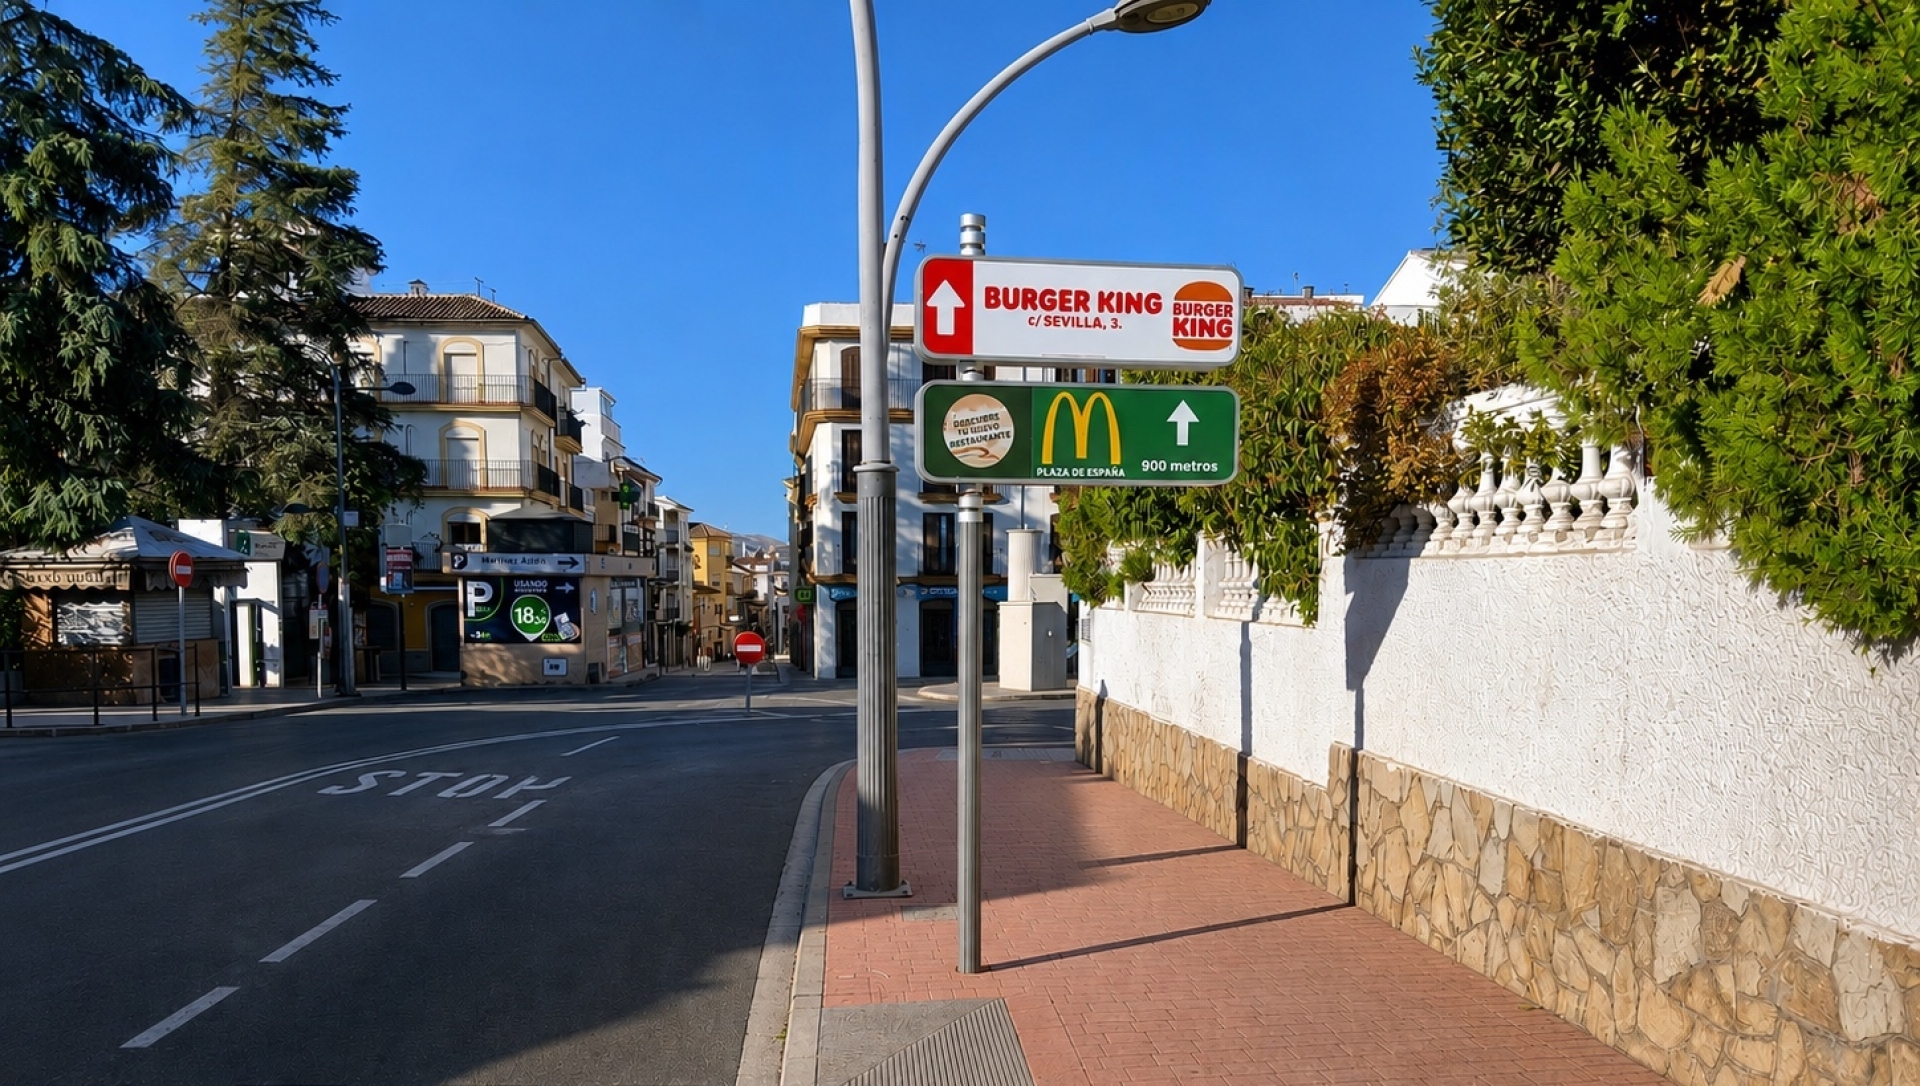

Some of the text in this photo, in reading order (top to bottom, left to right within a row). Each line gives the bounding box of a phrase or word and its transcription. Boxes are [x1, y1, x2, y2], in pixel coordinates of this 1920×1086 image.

[984, 286, 1163, 315] BURGER KING
[1173, 302, 1234, 318] BURGER
[1172, 316, 1233, 339] KING
[1036, 465, 1126, 477] PLAZA DE ESPAÑA
[1141, 459, 1218, 472] 900 metros
[466, 580, 493, 617] P
